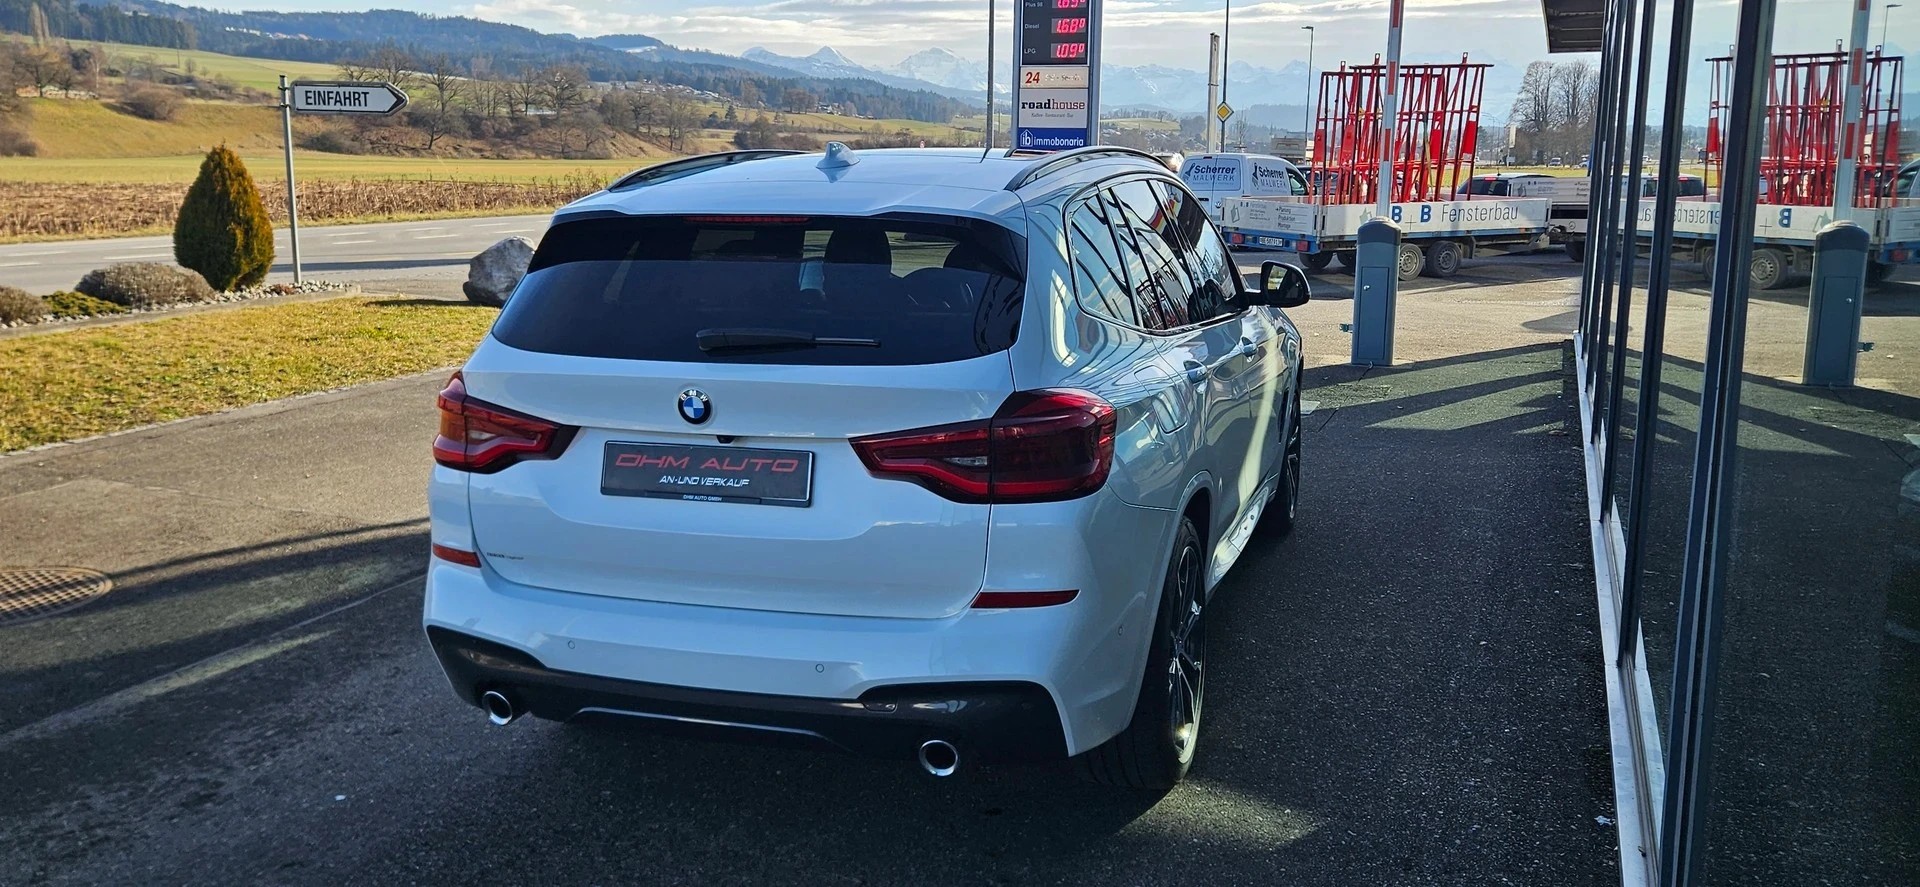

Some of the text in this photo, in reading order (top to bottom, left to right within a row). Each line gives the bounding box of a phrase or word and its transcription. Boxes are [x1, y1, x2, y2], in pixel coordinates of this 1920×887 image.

[1025, 71, 1041, 84] 24
[305, 90, 370, 107] EINFAHRT
[1021, 98, 1086, 110] roadhouse
[1033, 137, 1084, 146] immobonaria
[1194, 165, 1236, 175] Scherrer
[1258, 166, 1285, 180] Scherrer
[1193, 174, 1235, 182] MALWERK
[1391, 206, 1402, 223] B
[1420, 204, 1432, 223] B
[1441, 203, 1519, 223] Fensterbau
[700, 457, 799, 473] AUTO
[701, 477, 750, 487] VERKAUF
